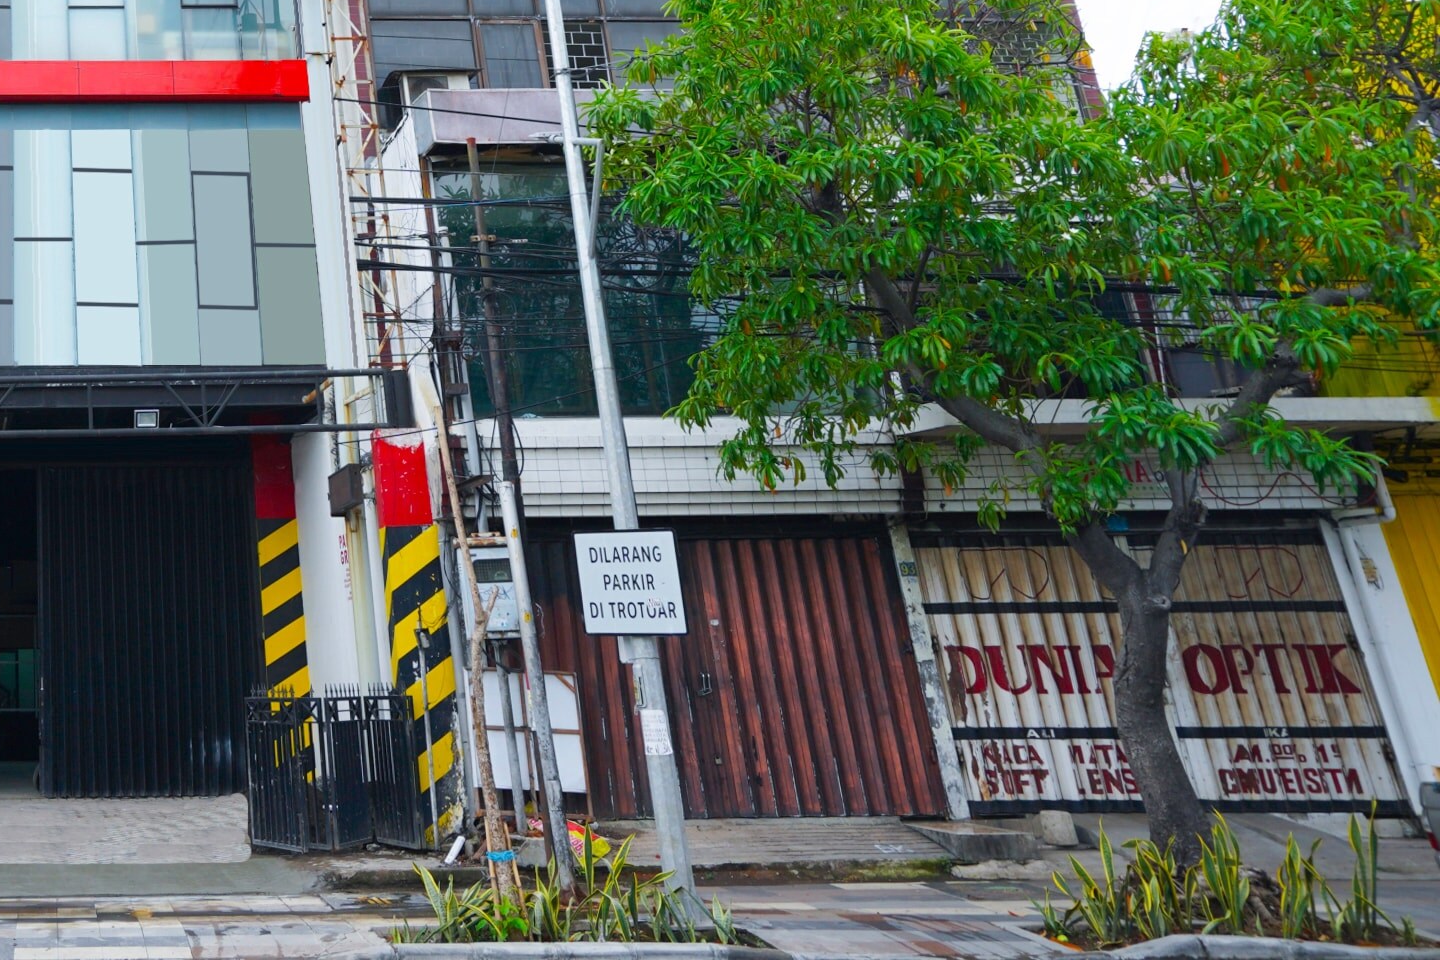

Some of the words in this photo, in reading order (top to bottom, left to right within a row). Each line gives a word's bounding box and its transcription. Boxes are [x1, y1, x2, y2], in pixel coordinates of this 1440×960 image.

[588, 546, 662, 563] DILARANG
[603, 574, 655, 591] PARKIR
[589, 602, 604, 618] DI
[608, 602, 677, 619] TROTUAR
[1182, 643, 1361, 695] OPTIK
